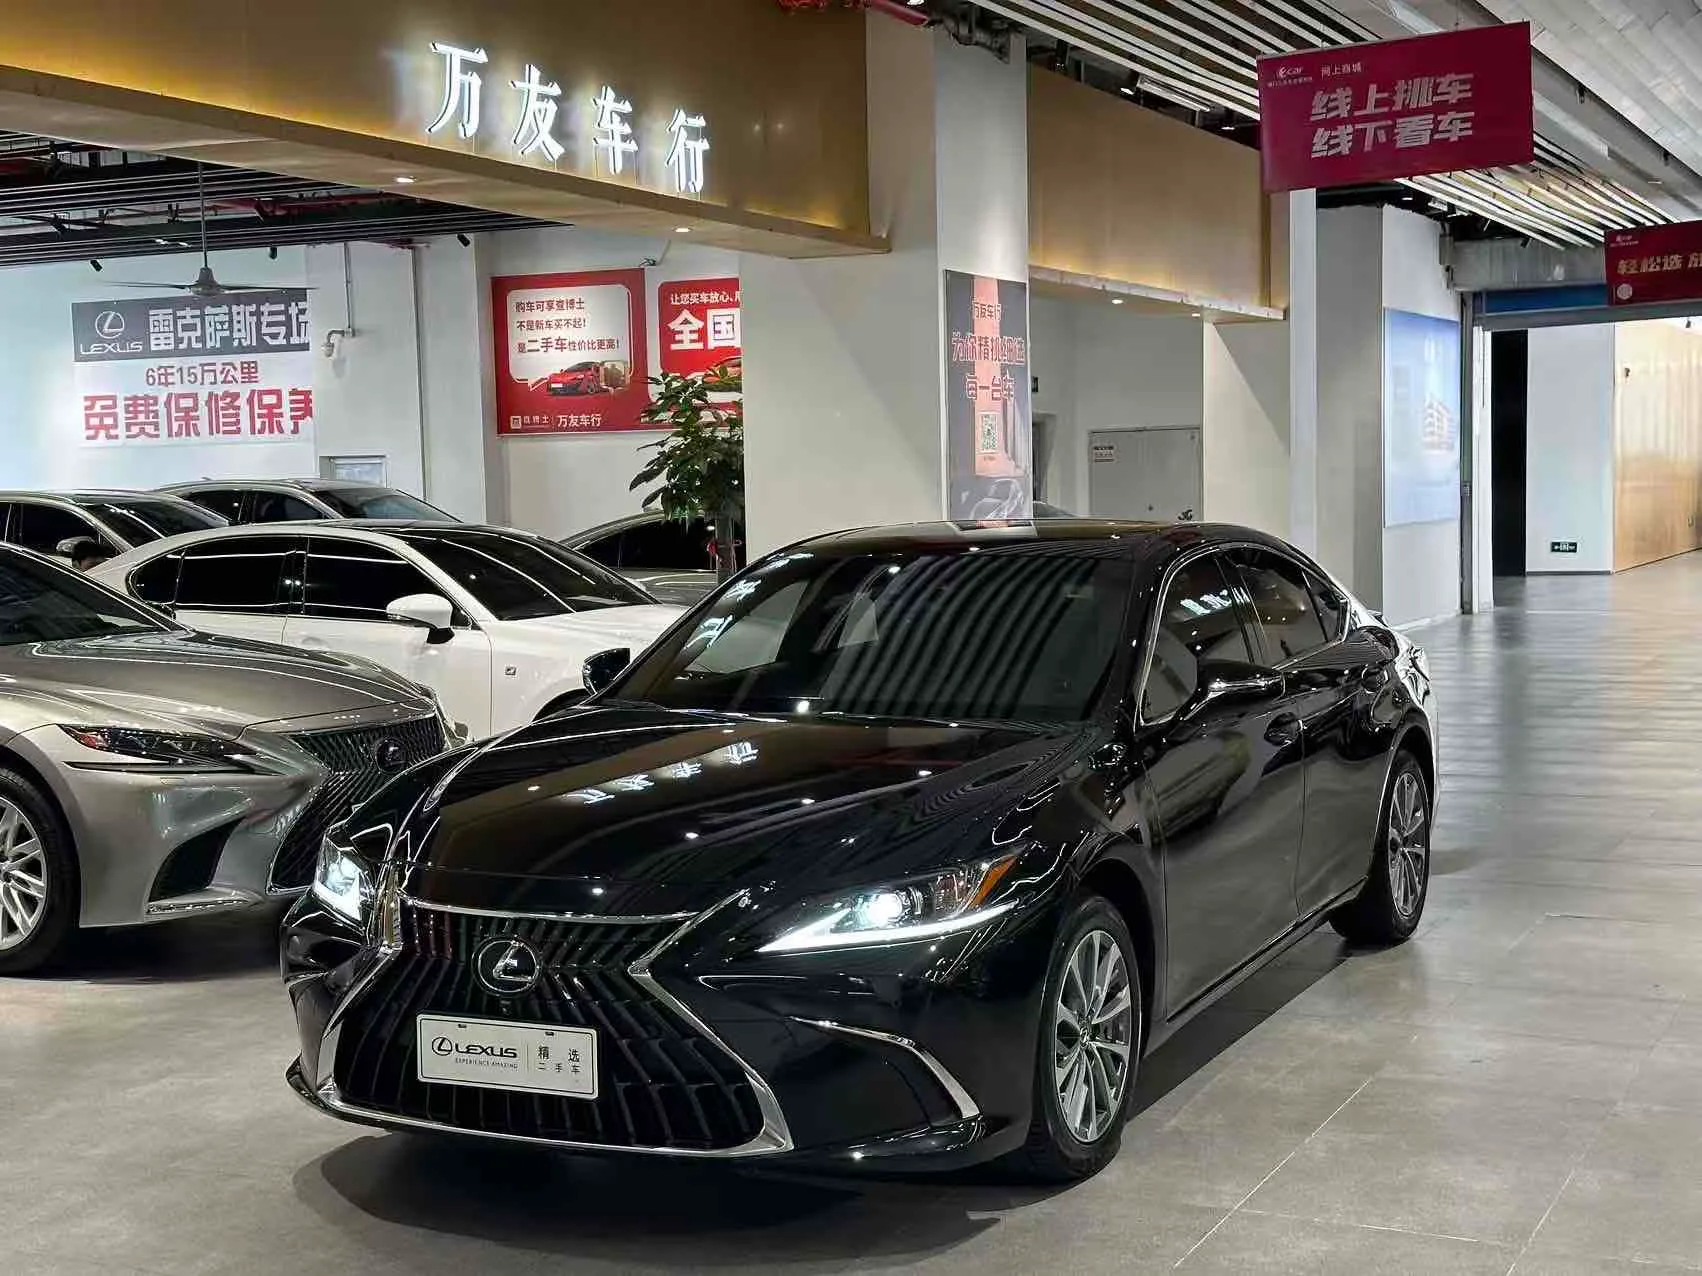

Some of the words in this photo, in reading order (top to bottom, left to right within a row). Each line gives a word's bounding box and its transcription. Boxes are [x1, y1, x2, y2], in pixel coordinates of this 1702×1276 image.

[1310, 73, 1475, 121] 线上挑车
[425, 40, 711, 194] 万友车行
[1311, 111, 1476, 158] 线下看车
[1616, 254, 1683, 275] 轻松选
[148, 302, 311, 352] 雷克萨斯专场
[79, 341, 144, 355] LEXUS
[146, 360, 260, 387] 6年15万公里
[557, 413, 602, 428] 万友车行
[454, 1043, 518, 1058] LEXUS
[537, 1046, 581, 1063] 精选
[455, 1057, 490, 1066] EXPERIENCE
[491, 1060, 519, 1069] AMAZING
[537, 1062, 582, 1075] 二手车
